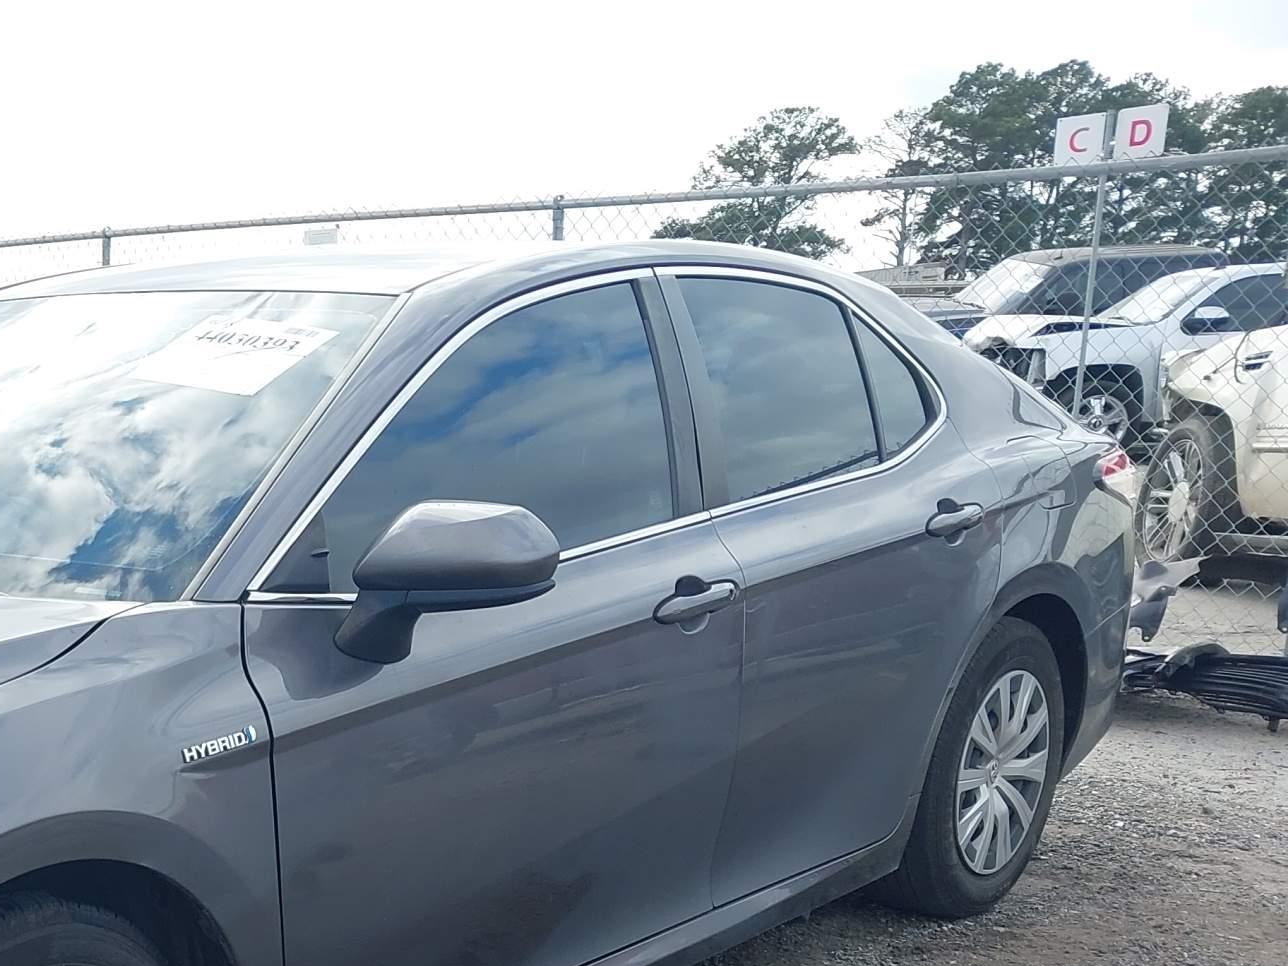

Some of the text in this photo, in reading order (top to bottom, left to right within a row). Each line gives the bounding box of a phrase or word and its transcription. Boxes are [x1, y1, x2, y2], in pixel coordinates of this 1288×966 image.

[1069, 127, 1090, 153] C
[1129, 119, 1153, 147] D
[182, 732, 249, 763] HYBRID
